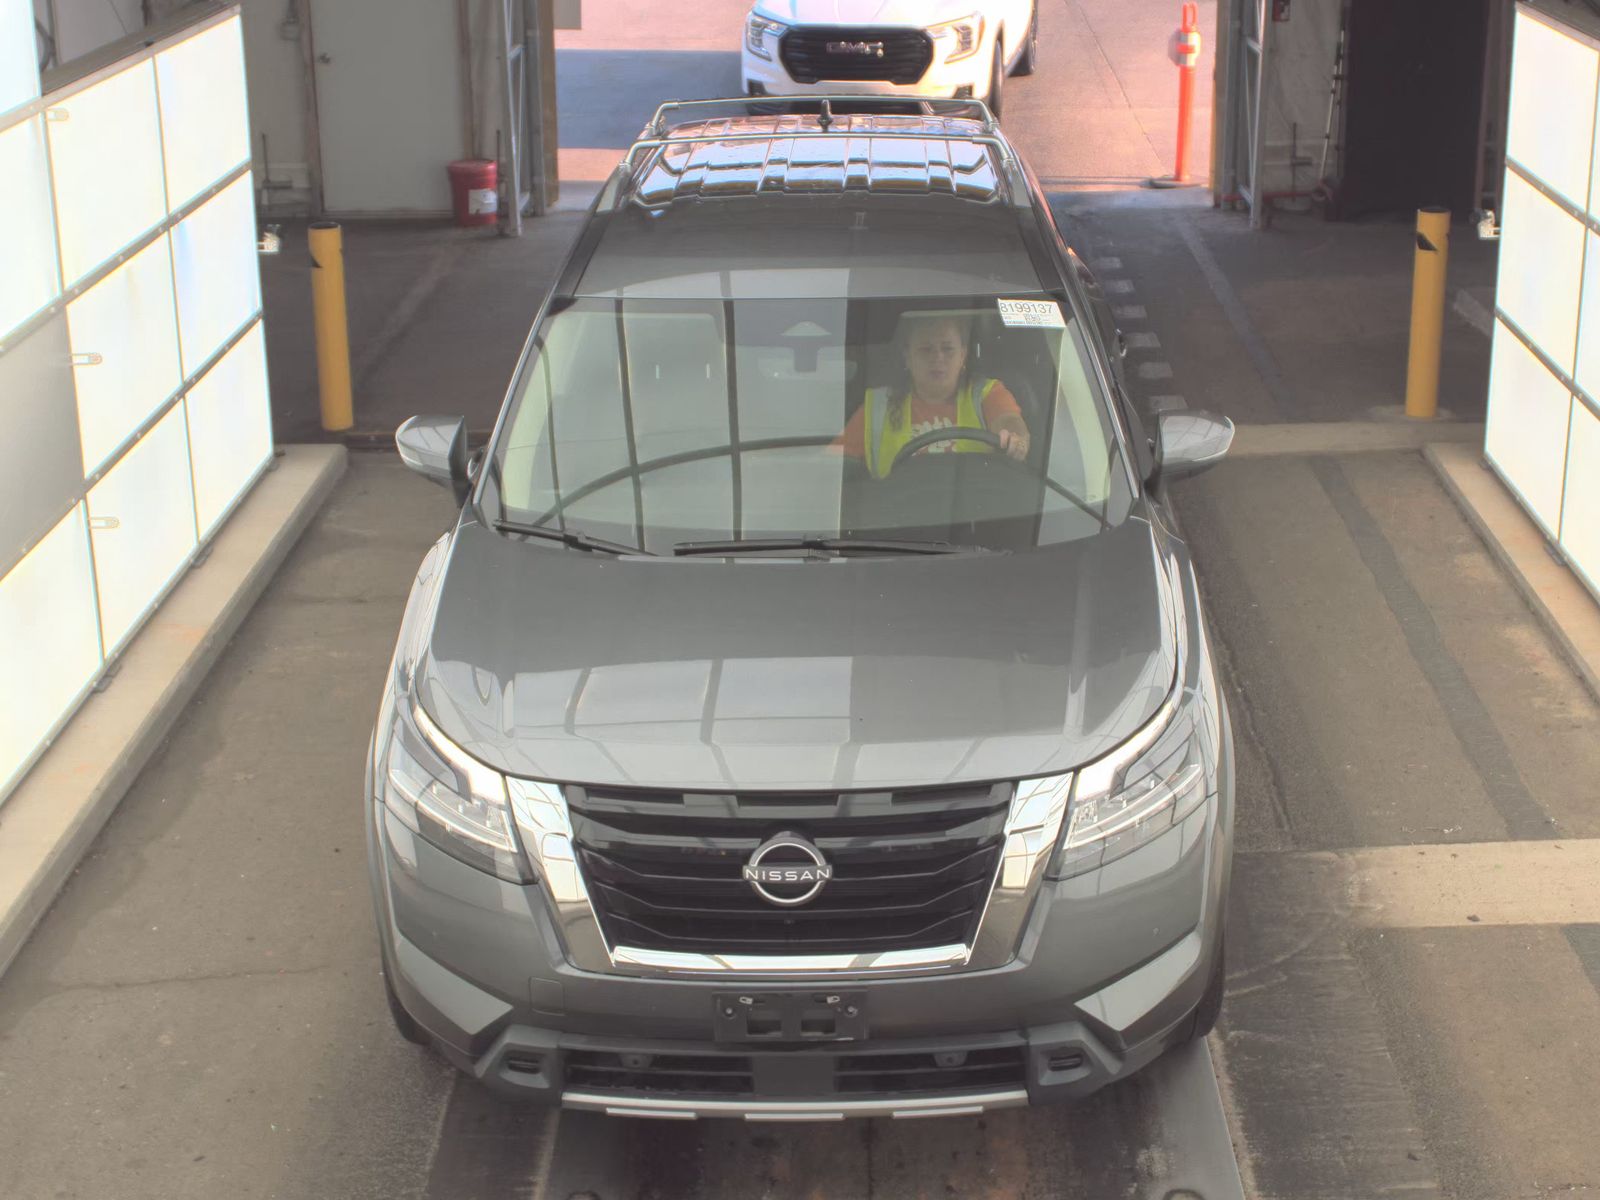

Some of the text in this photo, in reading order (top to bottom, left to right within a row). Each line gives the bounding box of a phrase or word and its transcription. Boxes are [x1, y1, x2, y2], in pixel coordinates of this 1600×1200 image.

[825, 41, 884, 57] GMC
[1000, 302, 1053, 314] 8199137
[745, 868, 829, 881] NISSAN
